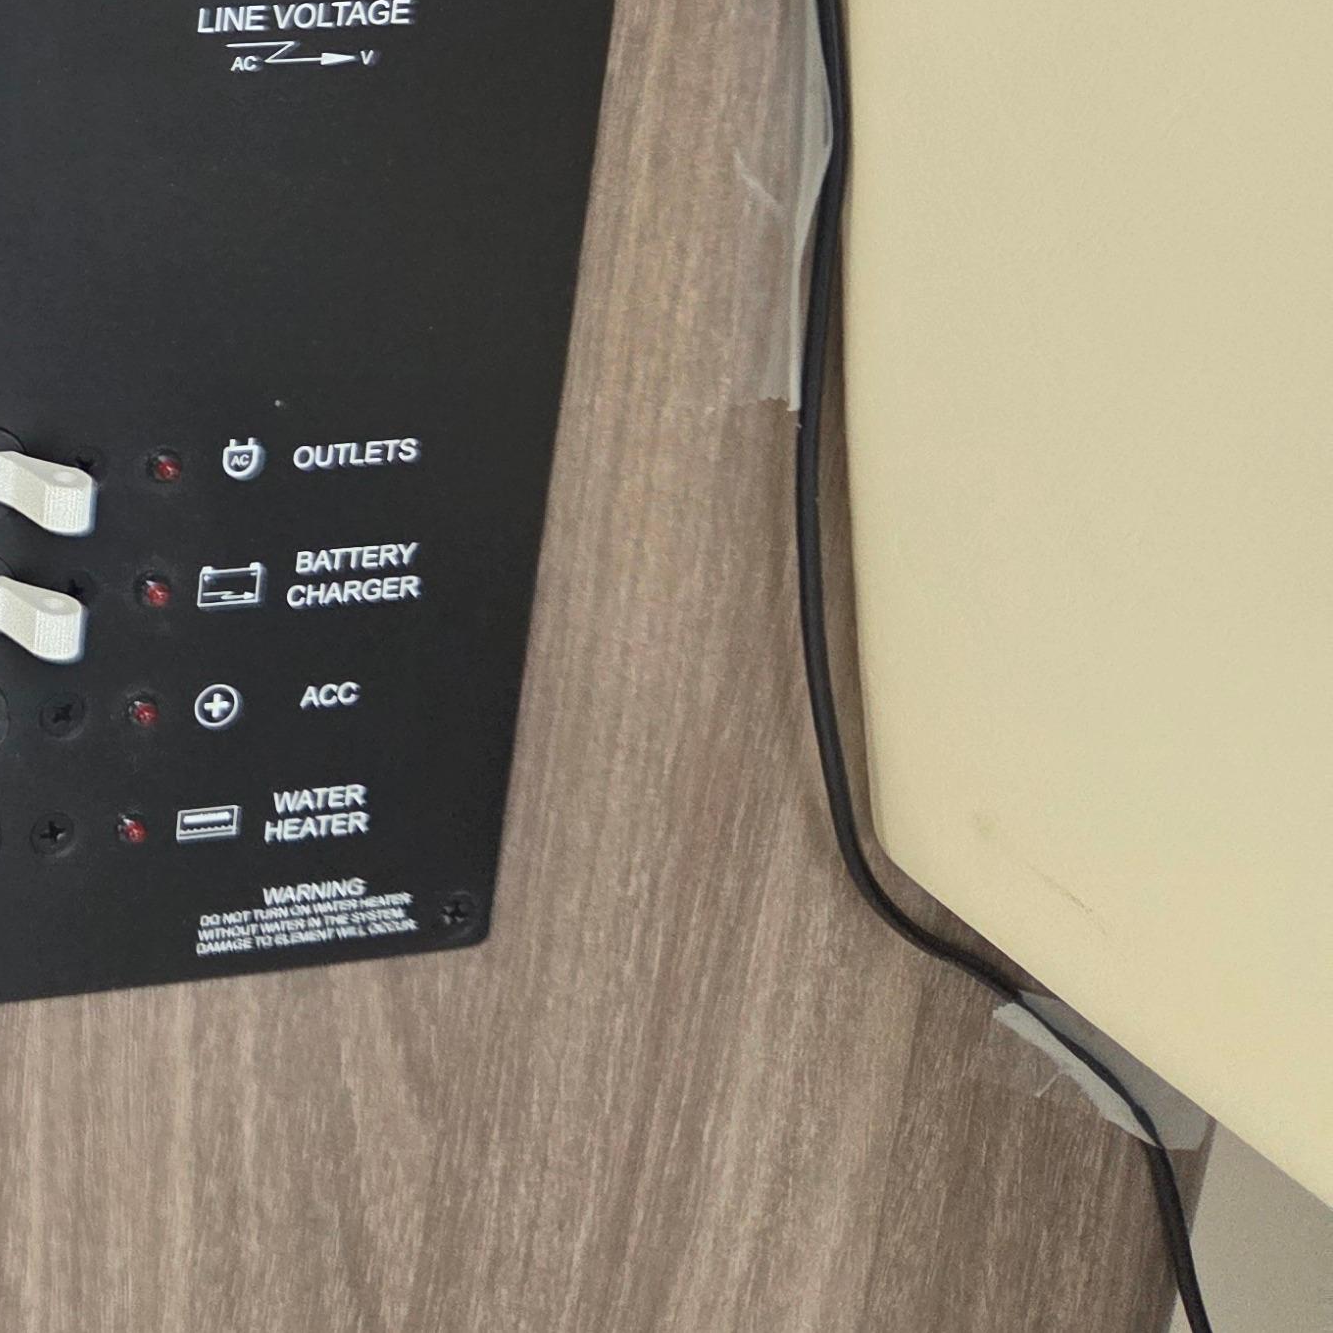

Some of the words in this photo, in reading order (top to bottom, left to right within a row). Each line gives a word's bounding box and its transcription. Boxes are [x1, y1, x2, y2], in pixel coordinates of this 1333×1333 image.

[197, 5, 268, 33] LINE
[273, 0, 414, 29] VOLTAGE
[231, 56, 258, 71] AC
[360, 50, 375, 65] V
[231, 454, 250, 467] AC
[293, 438, 419, 470] OUTLETS
[295, 542, 419, 574] BATTERY
[286, 575, 421, 609] CHARGER
[300, 682, 361, 709] ACC
[273, 784, 368, 813] WATER
[264, 811, 369, 843] HEATER
[263, 877, 367, 906] WARNING
[200, 915, 220, 926] DO
[222, 911, 251, 924] NOT
[253, 907, 288, 921] TURN
[290, 904, 311, 916] ON
[313, 899, 357, 914] WATER
[360, 892, 413, 906] HEATER
[196, 937, 253, 955] DAMAGE
[255, 935, 273, 947] TO
[274, 926, 334, 946] ELEMENT
[198, 923, 258, 941] WITHOUT
[260, 918, 305, 934] WATER
[307, 917, 322, 928] IN
[324, 913, 349, 927] THE
